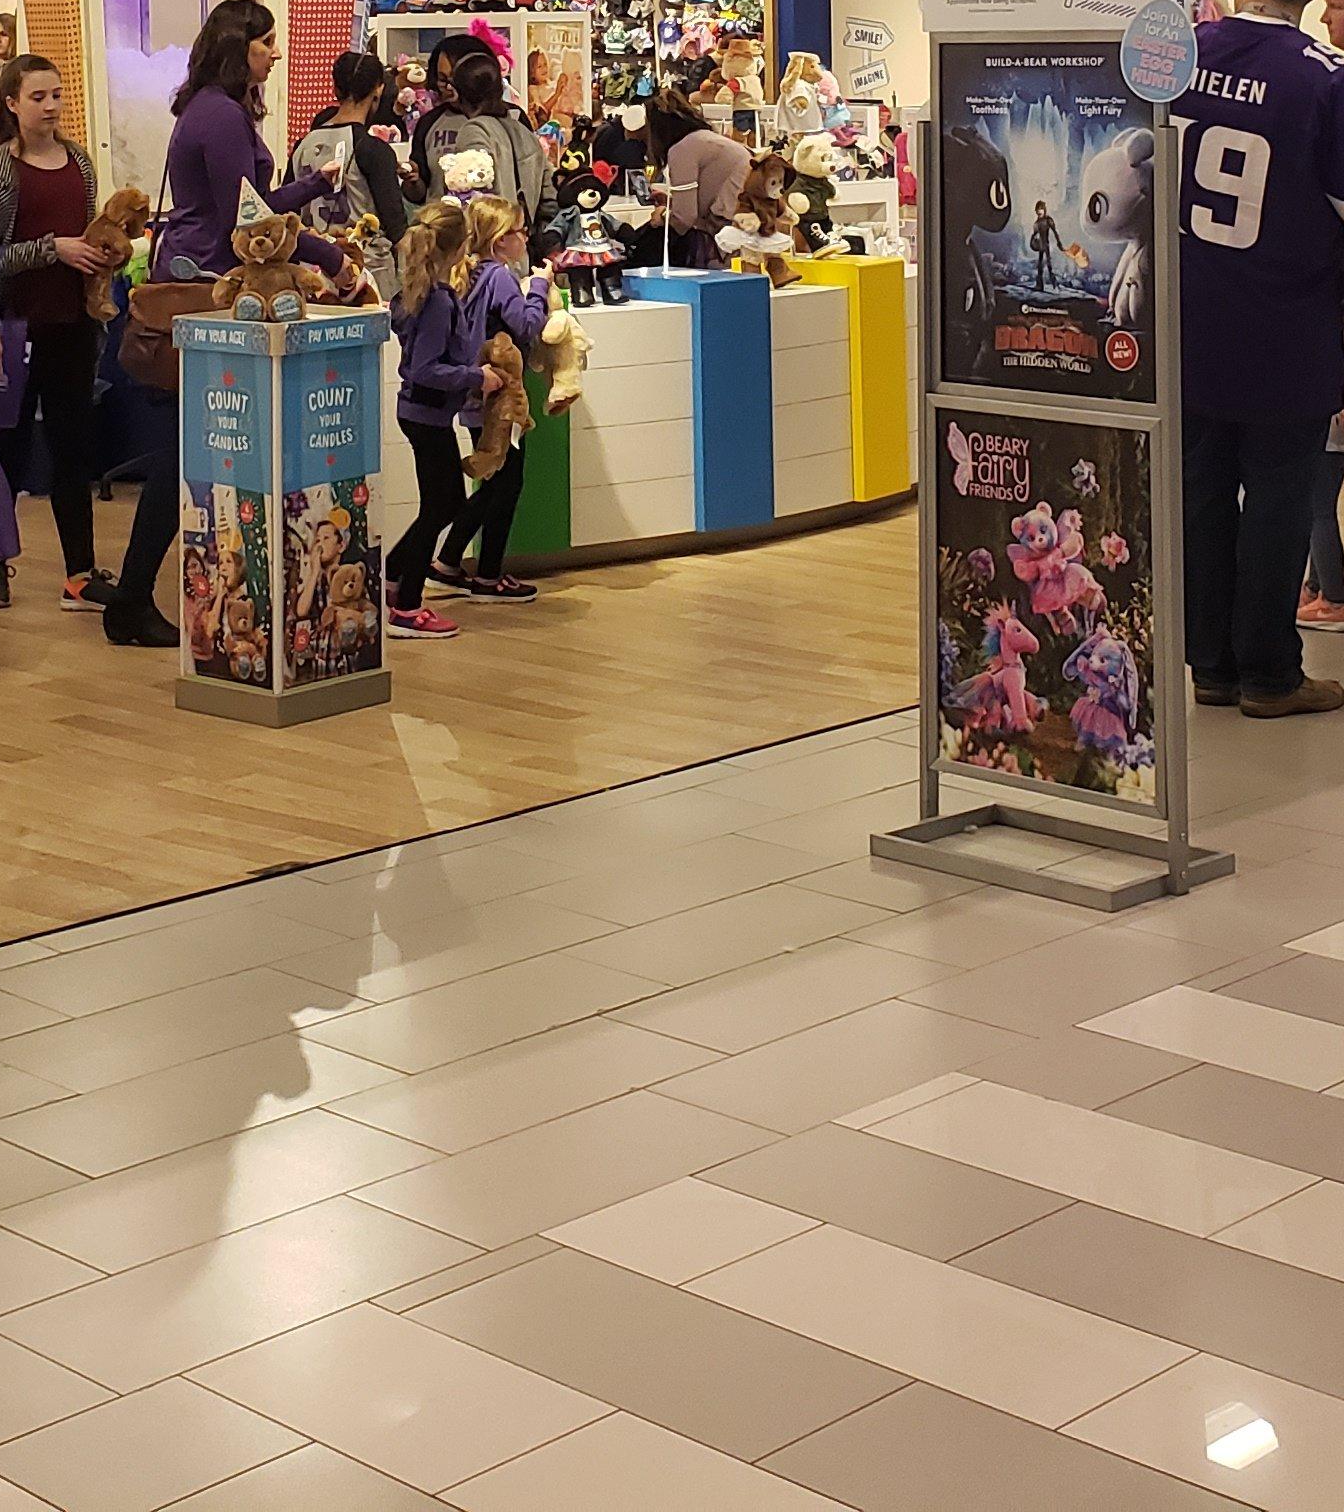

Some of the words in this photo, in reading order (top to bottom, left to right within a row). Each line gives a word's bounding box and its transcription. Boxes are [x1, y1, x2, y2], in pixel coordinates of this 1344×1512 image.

[1142, 8, 1168, 23] Join
[1170, 13, 1185, 28] Us
[854, 29, 883, 46] SMILE!
[1145, 23, 1162, 37] for
[1162, 27, 1178, 41] An
[985, 57, 1047, 67] BUILD-A-BEAR
[1050, 57, 1103, 66] WORKSHOP
[1140, 52, 1174, 74] EGG
[853, 69, 885, 89] IMAGINE
[1079, 104, 1102, 118] Light
[1104, 105, 1122, 117] Fury
[194, 327, 206, 343] PAY
[209, 328, 227, 344] YOUR
[308, 329, 322, 344] PAY
[325, 326, 344, 341] YOUR
[995, 324, 1098, 359] DRAGON
[1019, 355, 1058, 369] HIDDEN
[1059, 357, 1092, 374] WORLD
[207, 390, 249, 414] COUNT
[308, 387, 354, 412] COUNT
[217, 415, 238, 431] YOUR
[319, 412, 341, 428] YOUR
[208, 432, 249, 452] CANDLES
[309, 428, 354, 449] CANDLES
[985, 434, 1030, 457] BEARY
[969, 482, 1013, 501] FRIENDS
